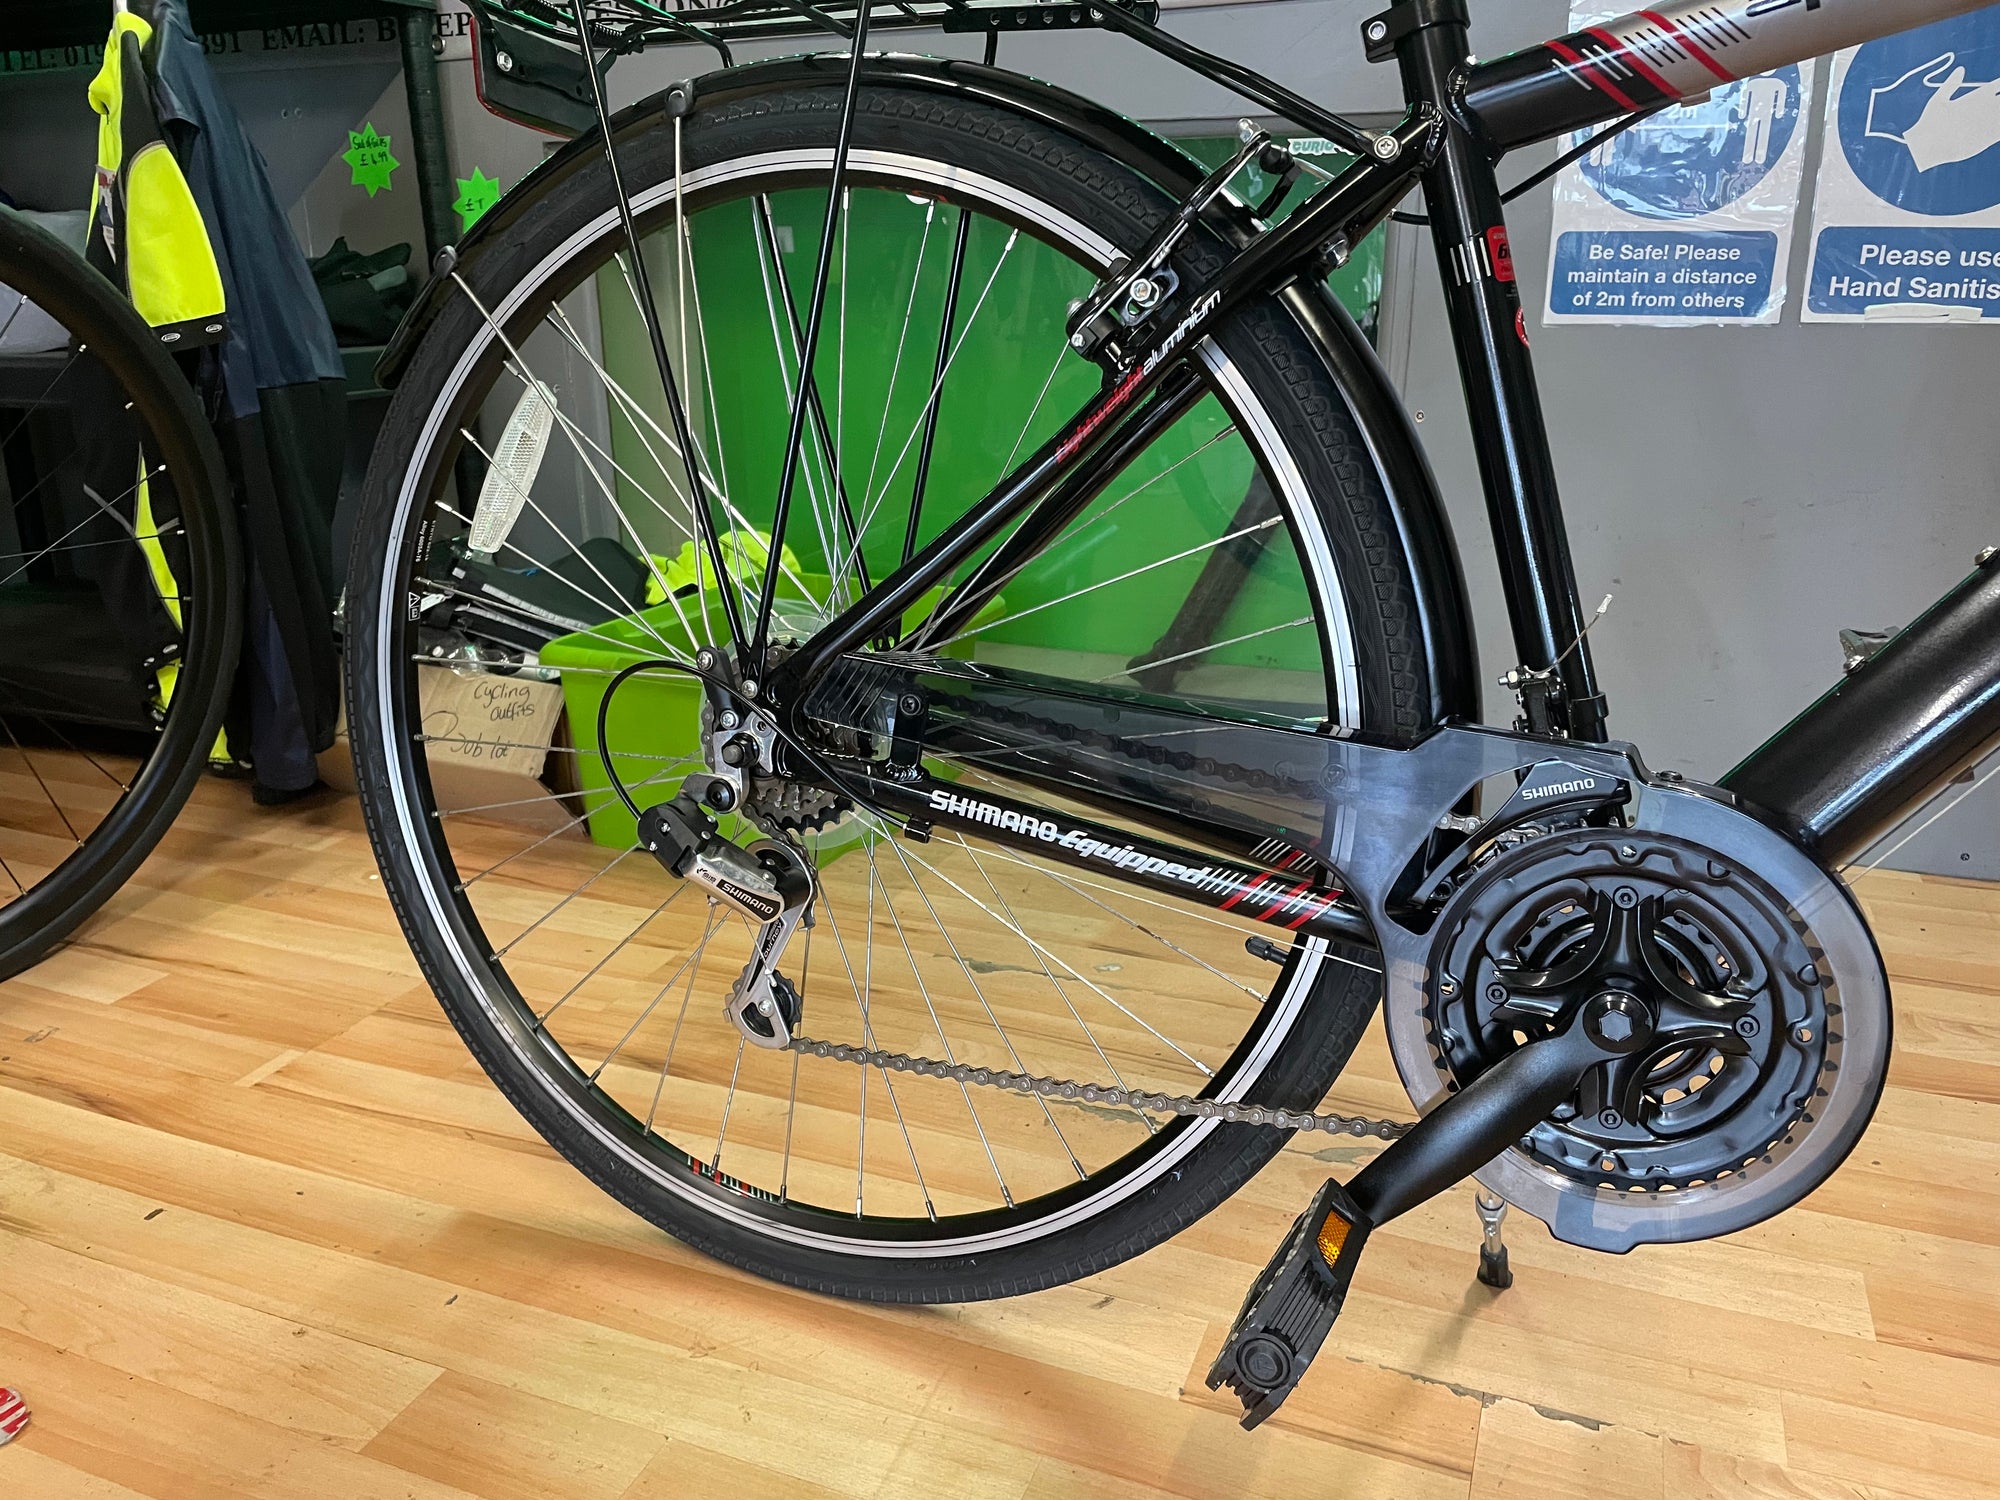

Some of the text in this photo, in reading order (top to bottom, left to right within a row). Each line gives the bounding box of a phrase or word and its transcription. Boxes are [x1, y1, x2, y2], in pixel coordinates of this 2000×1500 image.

[262, 20, 365, 50] EMAIL:
[1588, 244, 1741, 261] Be Safe! Please
[1859, 244, 1951, 266] Please
[1567, 268, 1757, 285] maintain a distance
[1828, 276, 1901, 298] Hand
[1572, 291, 1746, 309] of 2m from others
[1142, 289, 1222, 377] aluminium
[474, 681, 530, 709] Cycling
[1521, 778, 1596, 801] SHIMANO
[929, 789, 1208, 889] SHIMANO Equipped
[721, 883, 774, 915] SHIMANO
